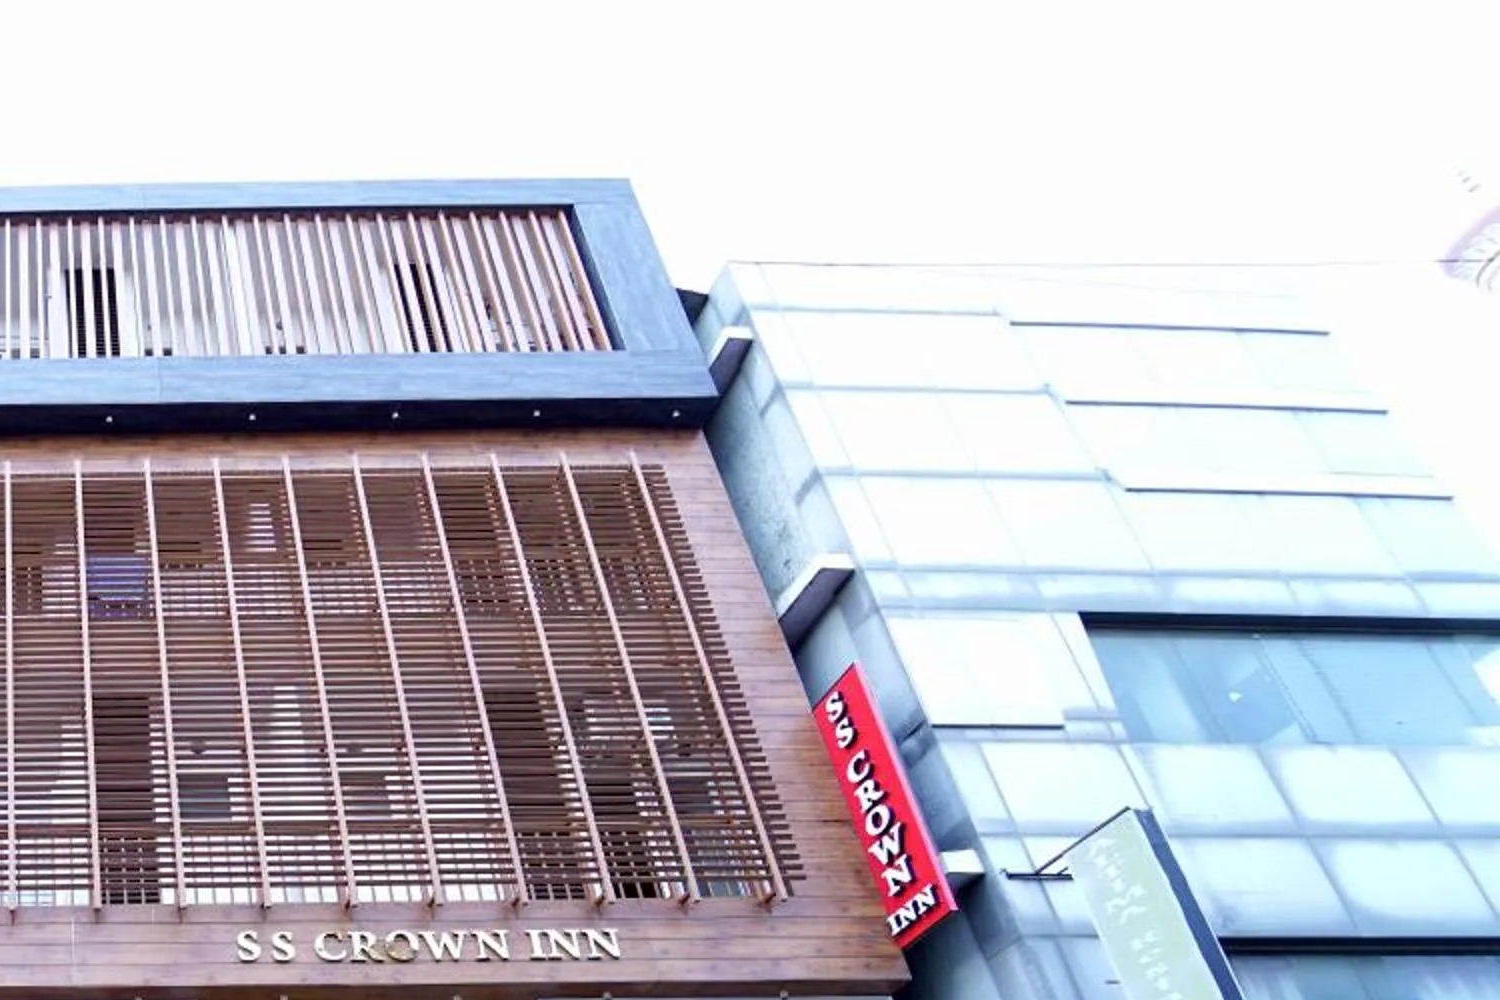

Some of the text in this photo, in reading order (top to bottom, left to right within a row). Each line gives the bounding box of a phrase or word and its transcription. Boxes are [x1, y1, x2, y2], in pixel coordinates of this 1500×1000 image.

[825, 691, 854, 748] S S
[847, 750, 913, 896] CROWN
[886, 884, 937, 936] INN
[236, 928, 620, 963] S S CROWN INN
